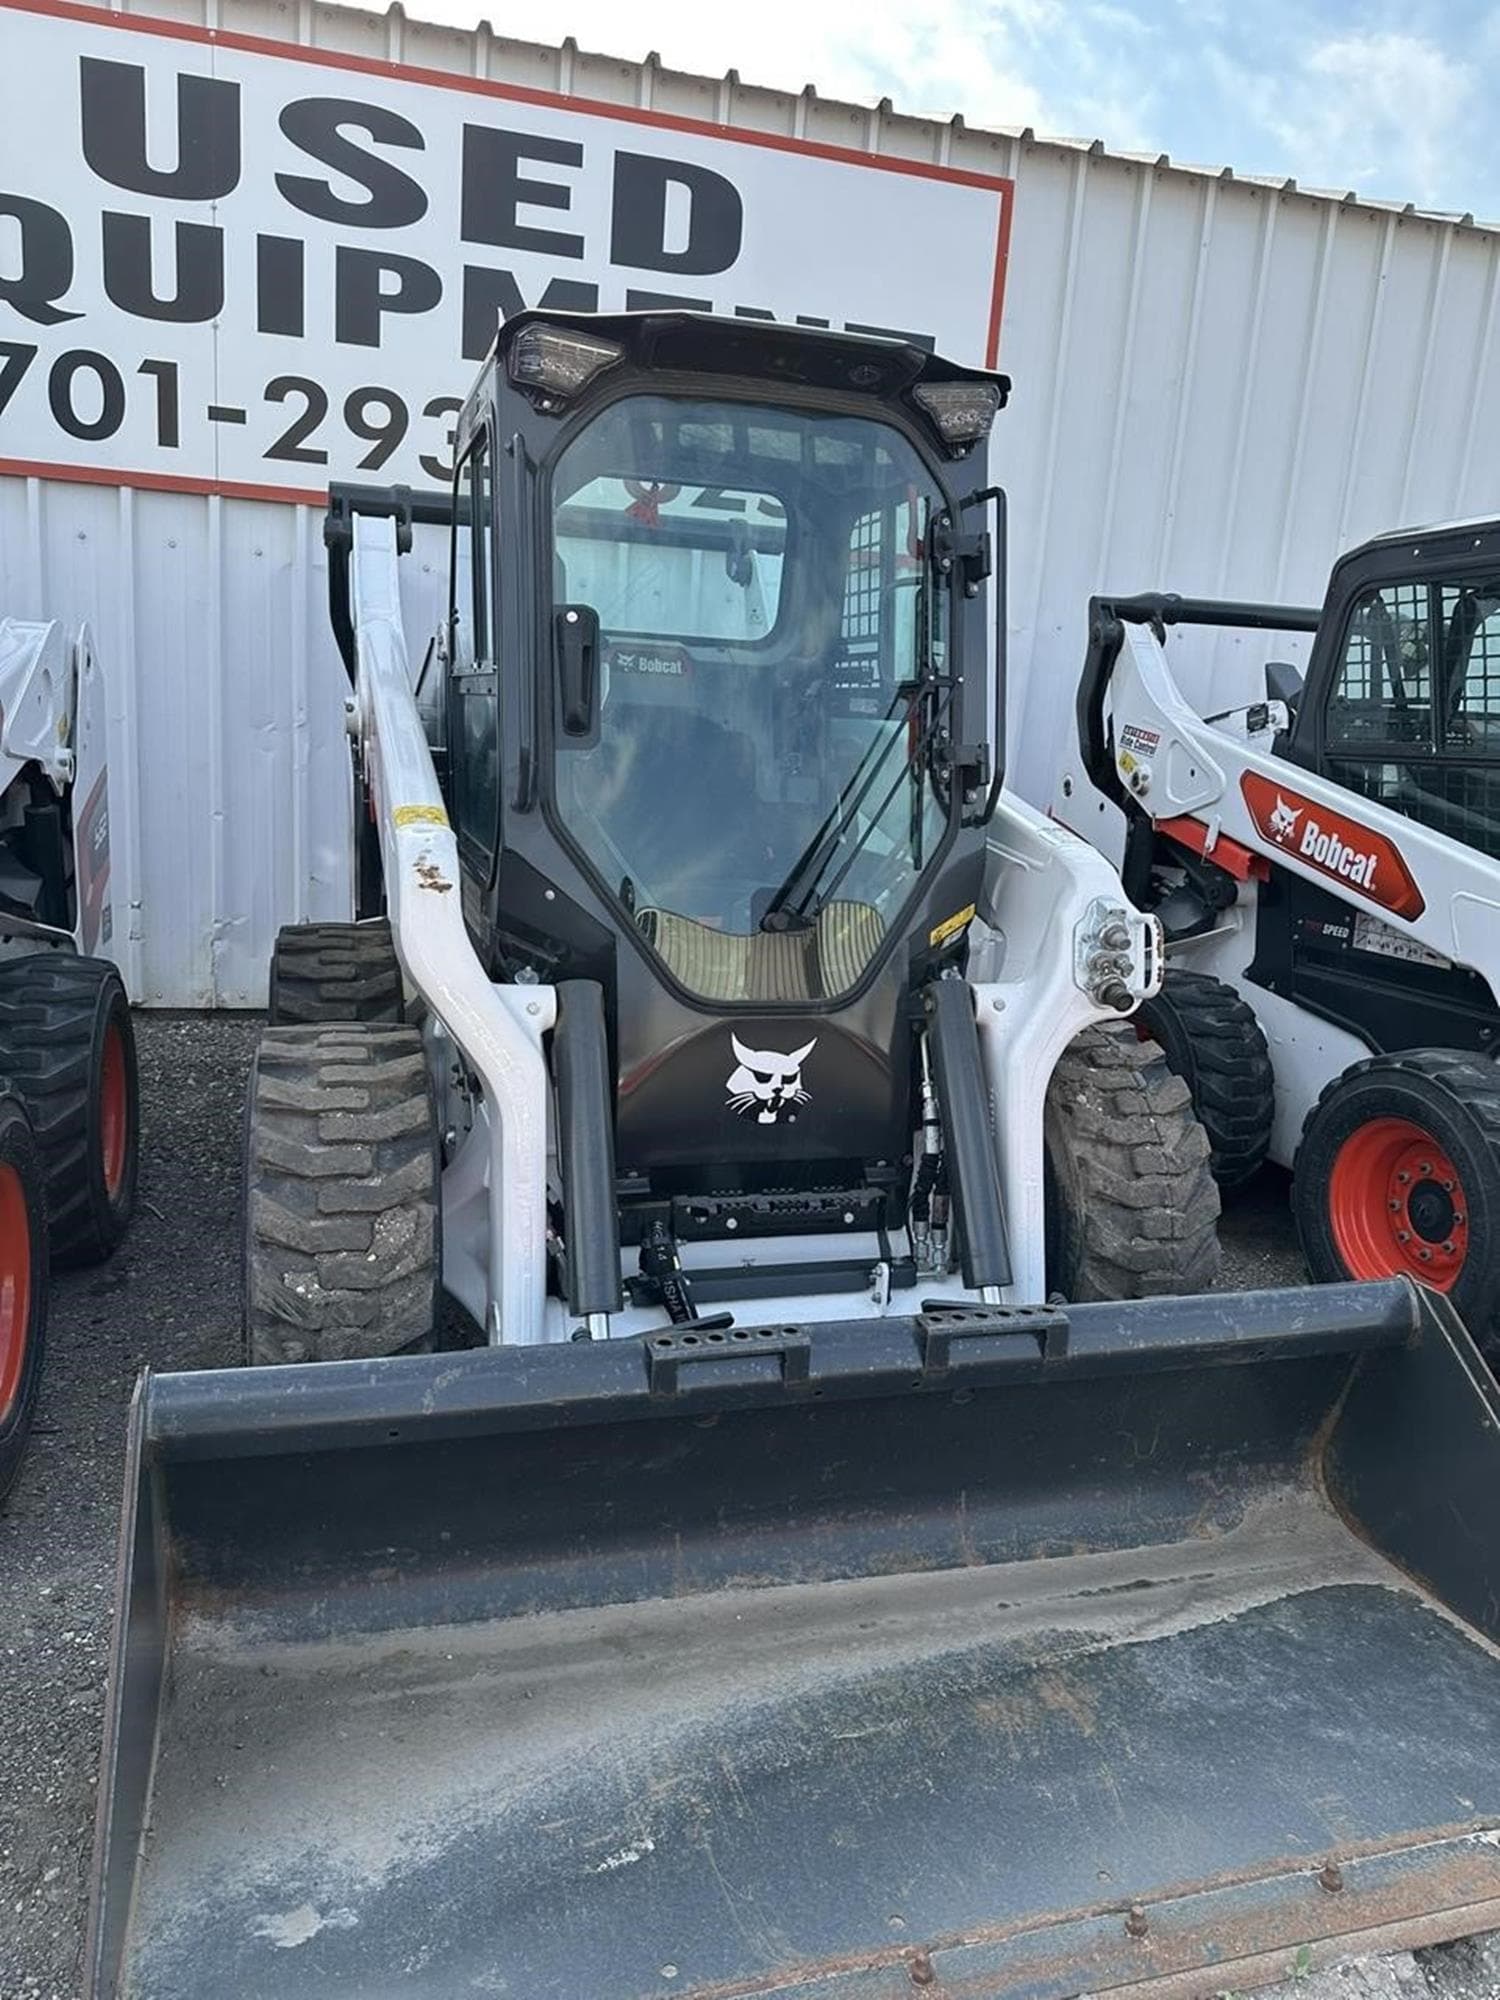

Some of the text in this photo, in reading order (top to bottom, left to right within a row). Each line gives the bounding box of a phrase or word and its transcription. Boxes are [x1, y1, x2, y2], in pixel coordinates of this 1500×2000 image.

[80, 55, 743, 276] USED
[0, 193, 936, 361] QUIPM
[639, 657, 682, 674] Bobcat
[1300, 820, 1377, 889] Bobcat
[1322, 923, 1350, 938] SPEED
